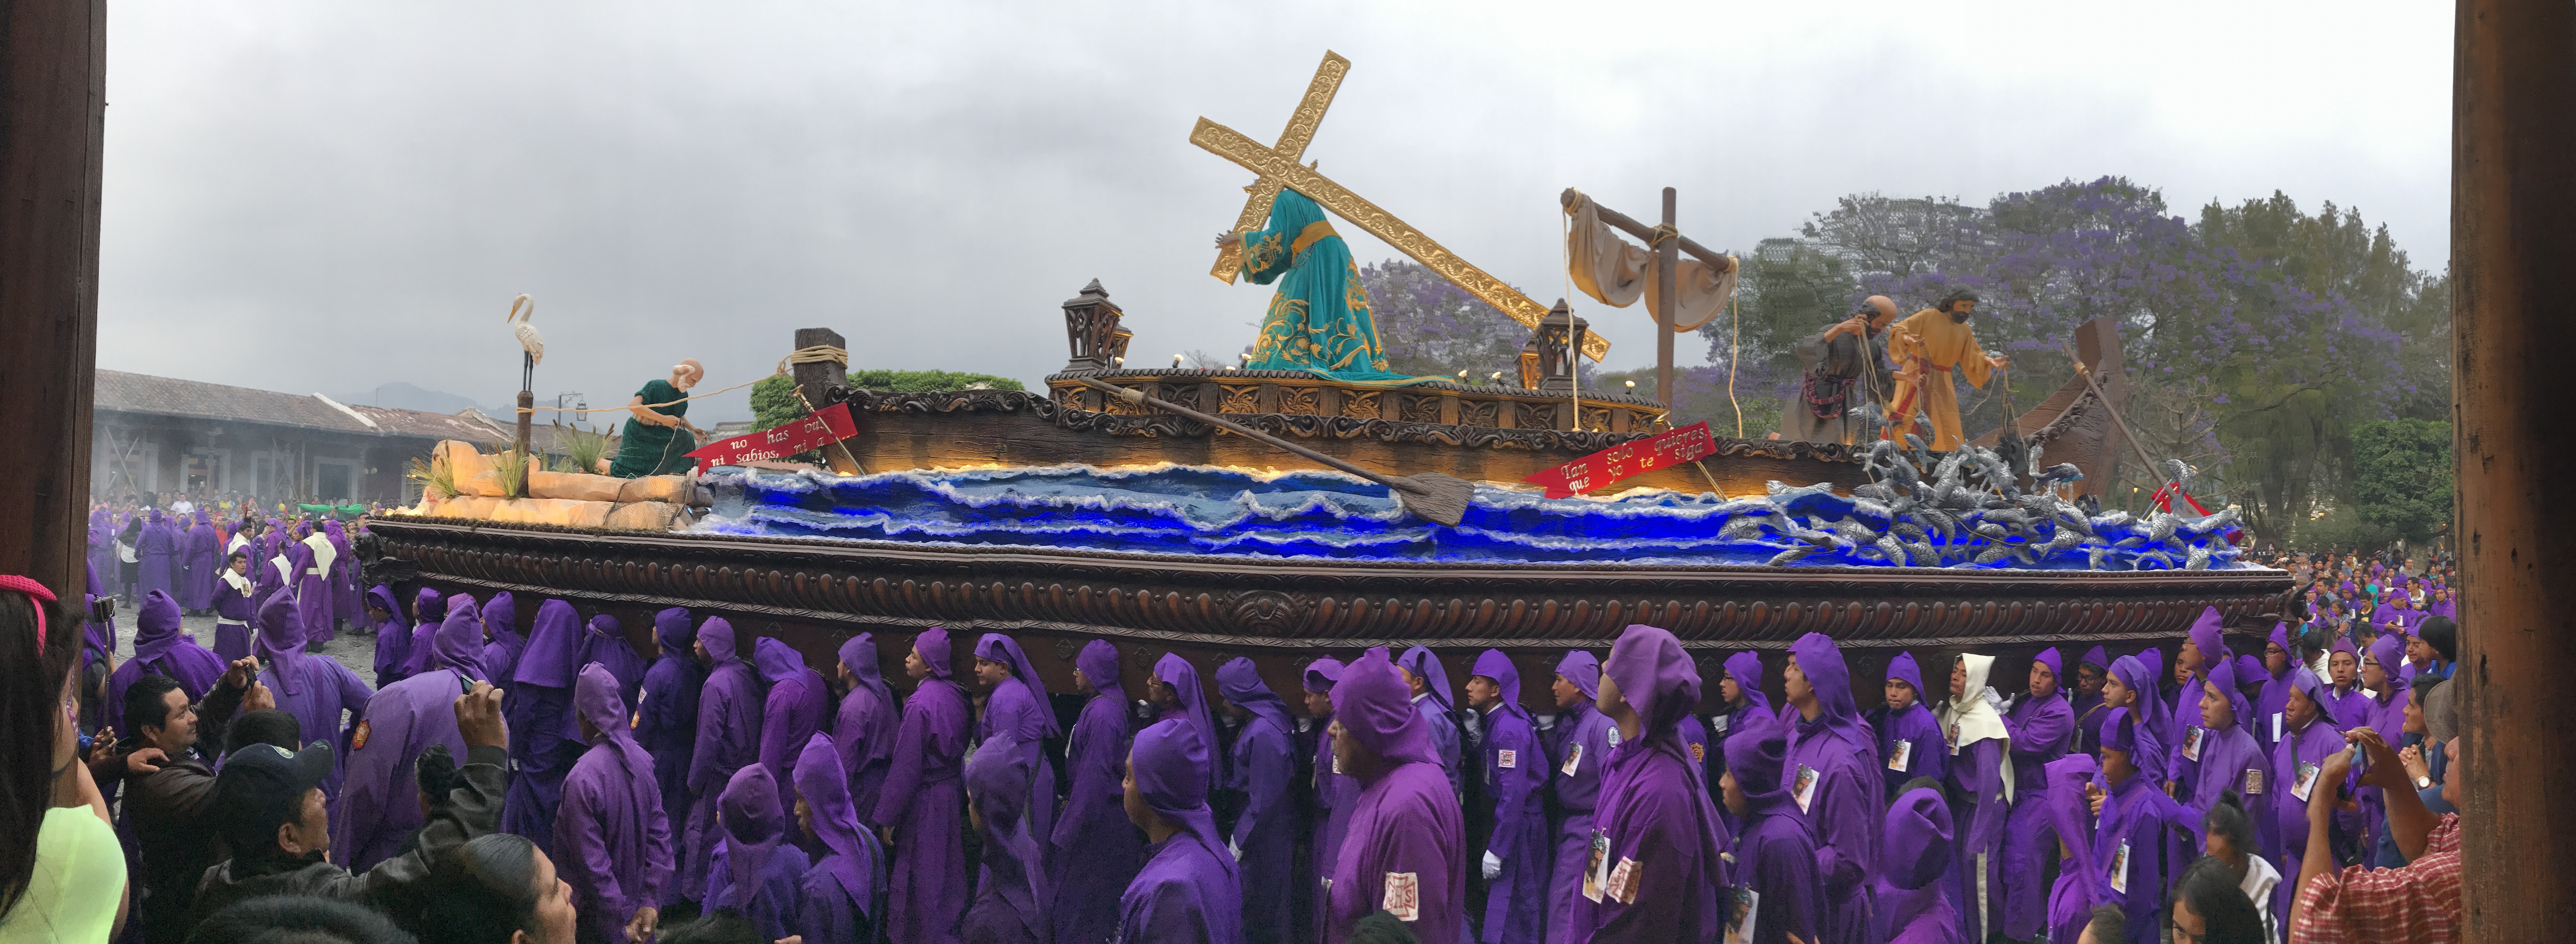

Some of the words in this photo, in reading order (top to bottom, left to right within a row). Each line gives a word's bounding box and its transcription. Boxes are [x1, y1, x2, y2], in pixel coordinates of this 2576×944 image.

[710, 455, 726, 467] ni
[736, 448, 779, 463] sabios,
[793, 439, 807, 454] ni
[817, 437, 825, 446] a
[730, 439, 747, 450] no
[767, 429, 789, 445] has
[804, 418, 824, 433] bu
[1561, 462, 1588, 479] Tan
[1607, 443, 1634, 464] solo
[1654, 428, 1707, 456] quieres,
[1569, 476, 1590, 496] que
[1608, 465, 1623, 484] yo
[1639, 457, 1654, 468] te
[1675, 442, 1704, 461] siga
